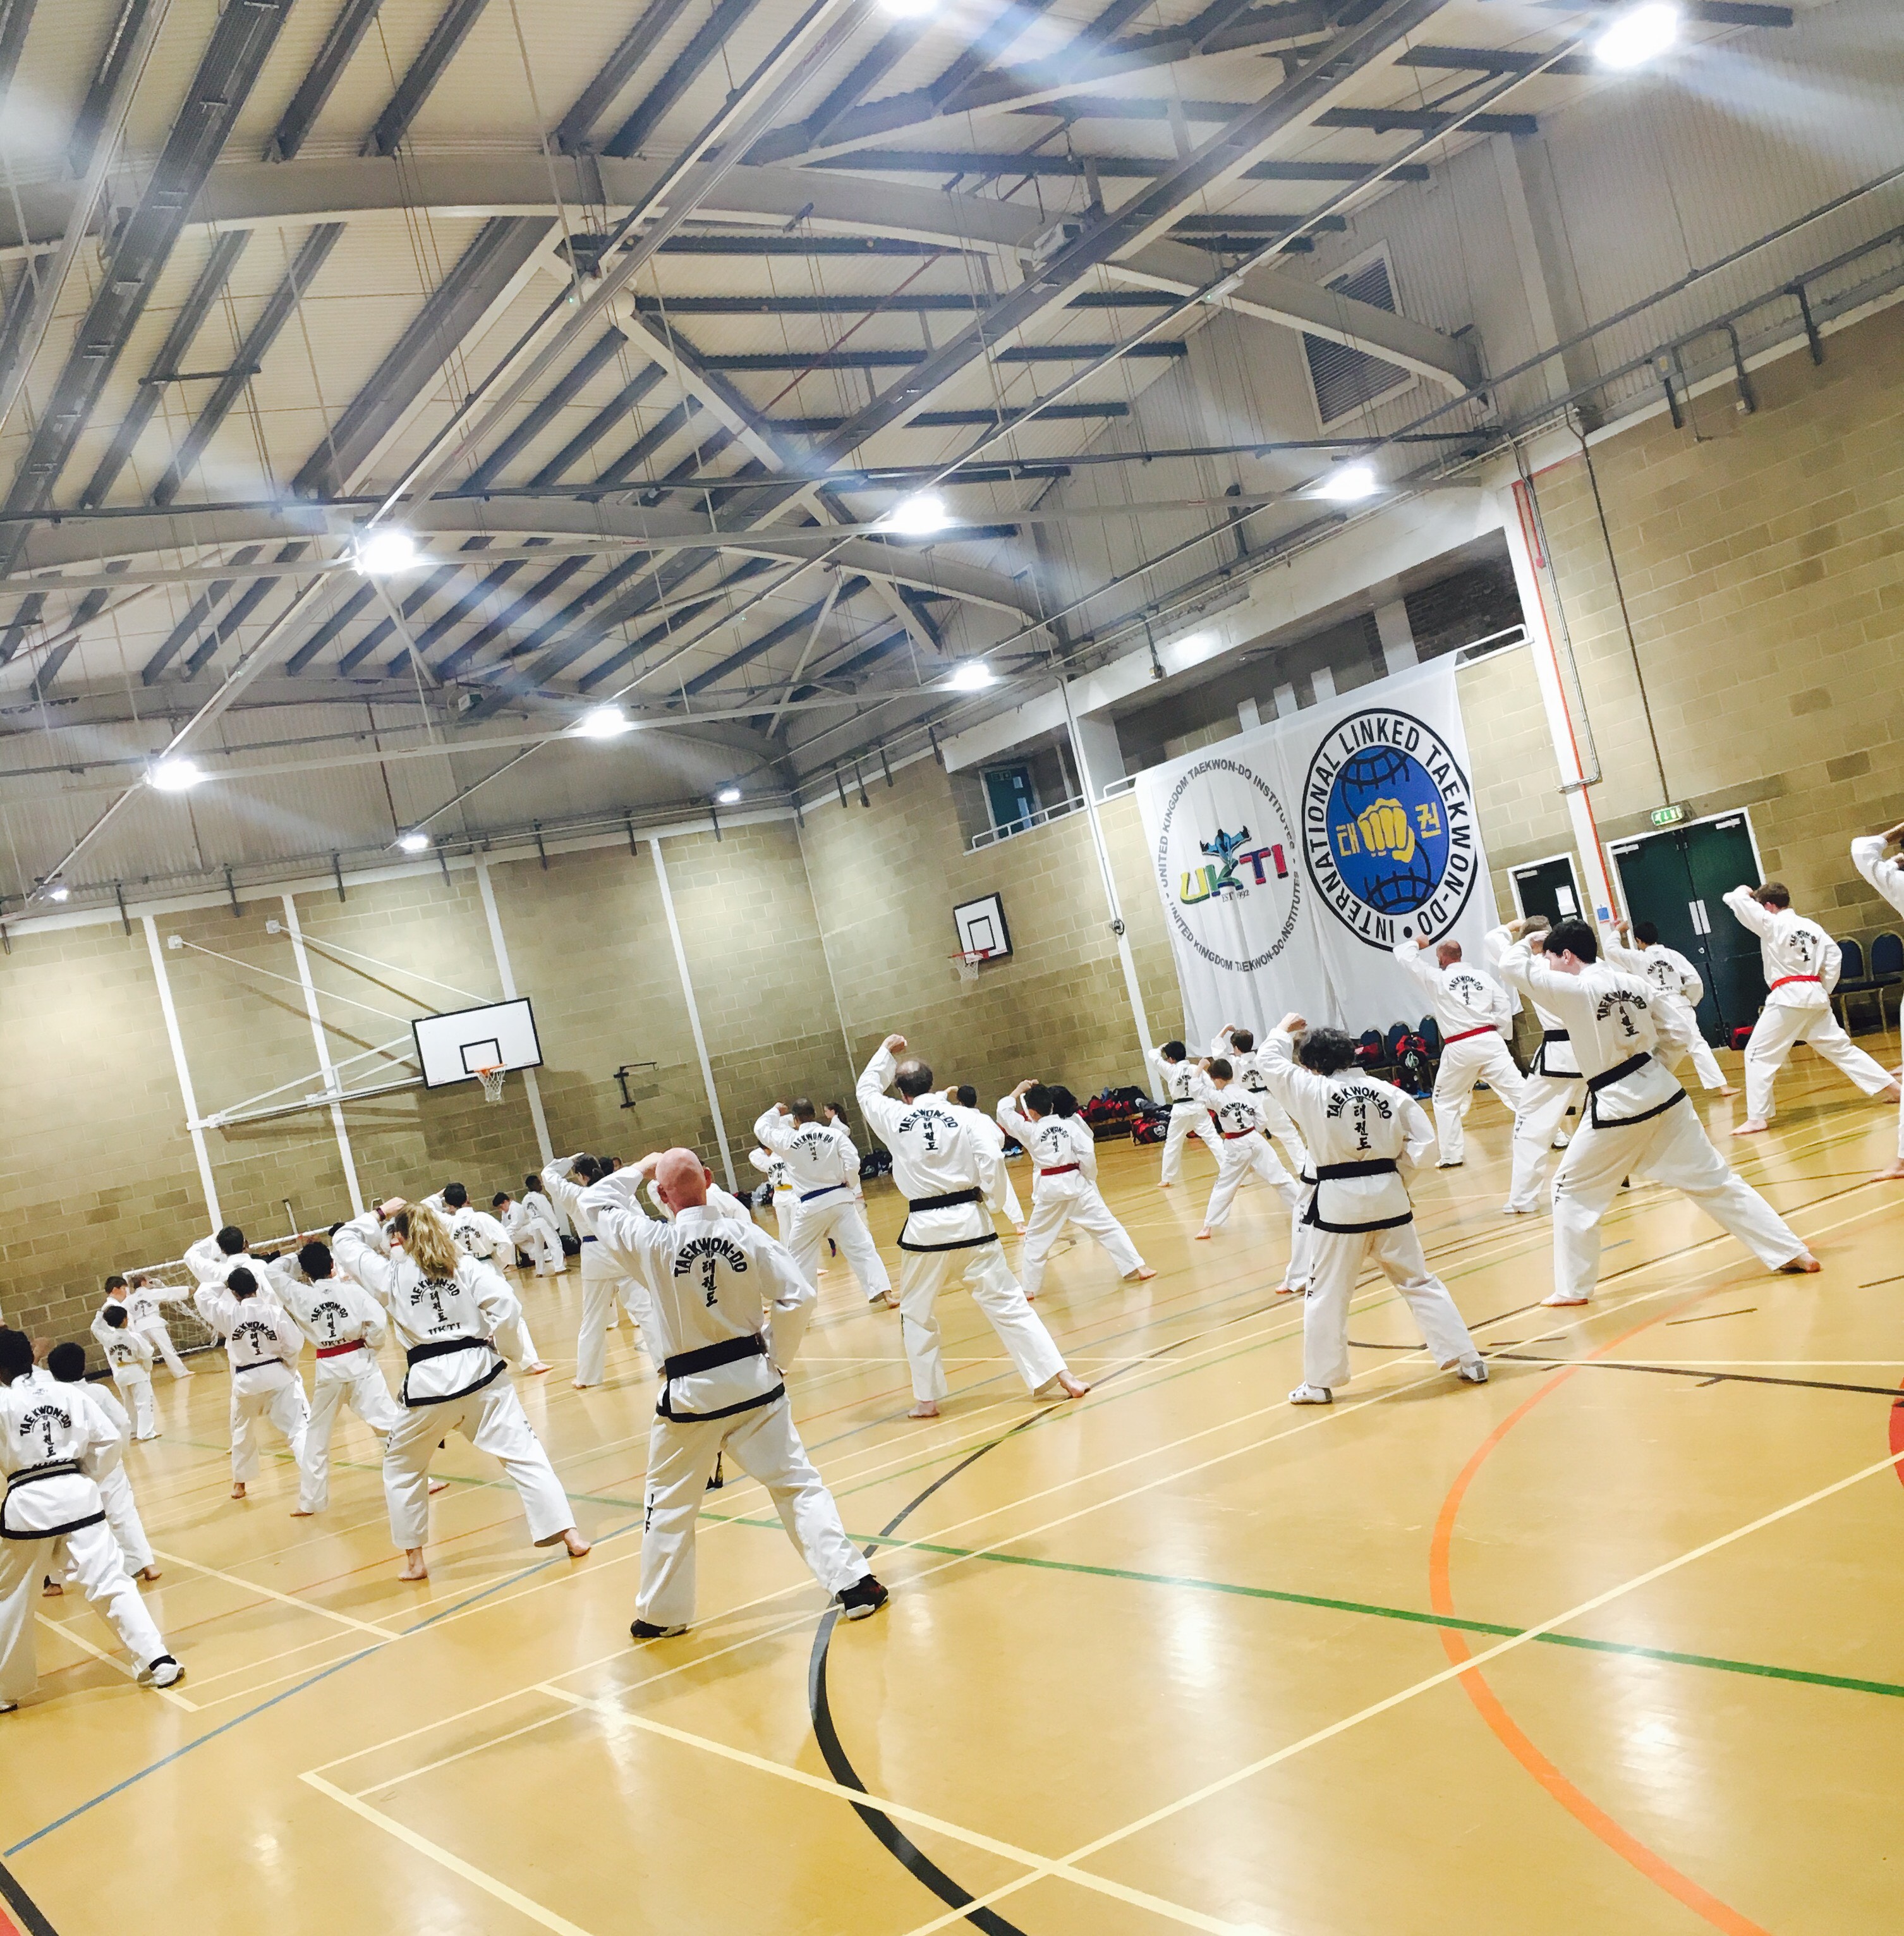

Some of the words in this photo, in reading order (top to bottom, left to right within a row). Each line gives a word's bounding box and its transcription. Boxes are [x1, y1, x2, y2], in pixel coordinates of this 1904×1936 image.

[1338, 717, 1419, 755] LINKED
[1187, 758, 1252, 780] TAEKWON-DO
[1162, 776, 1189, 832] KINGDOM
[1308, 752, 1394, 944] INTERNATIONAL
[1336, 823, 1360, 857] 태
[1415, 802, 1441, 839] 권
[1417, 744, 1471, 935] TAEKWON-DO
[1158, 835, 1168, 887] UNITED
[1180, 844, 1289, 904] UKTI
[1194, 939, 1232, 971] KINGDOM
[1235, 939, 1284, 972] TAEKWON-DO
[899, 1109, 959, 1133] TAEKWON-DO
[1326, 1087, 1393, 1119] TAEKWON-DO
[790, 1132, 834, 1150] TAEKWON-DO
[1555, 1174, 1566, 1205] ITF
[674, 1237, 748, 1277] TAEKWON-DO
[1306, 1263, 1316, 1300] ITF
[320, 1337, 347, 1347] UKTI
[20, 1405, 71, 1437] TAEKWON-DO
[645, 1493, 655, 1535] ITF
